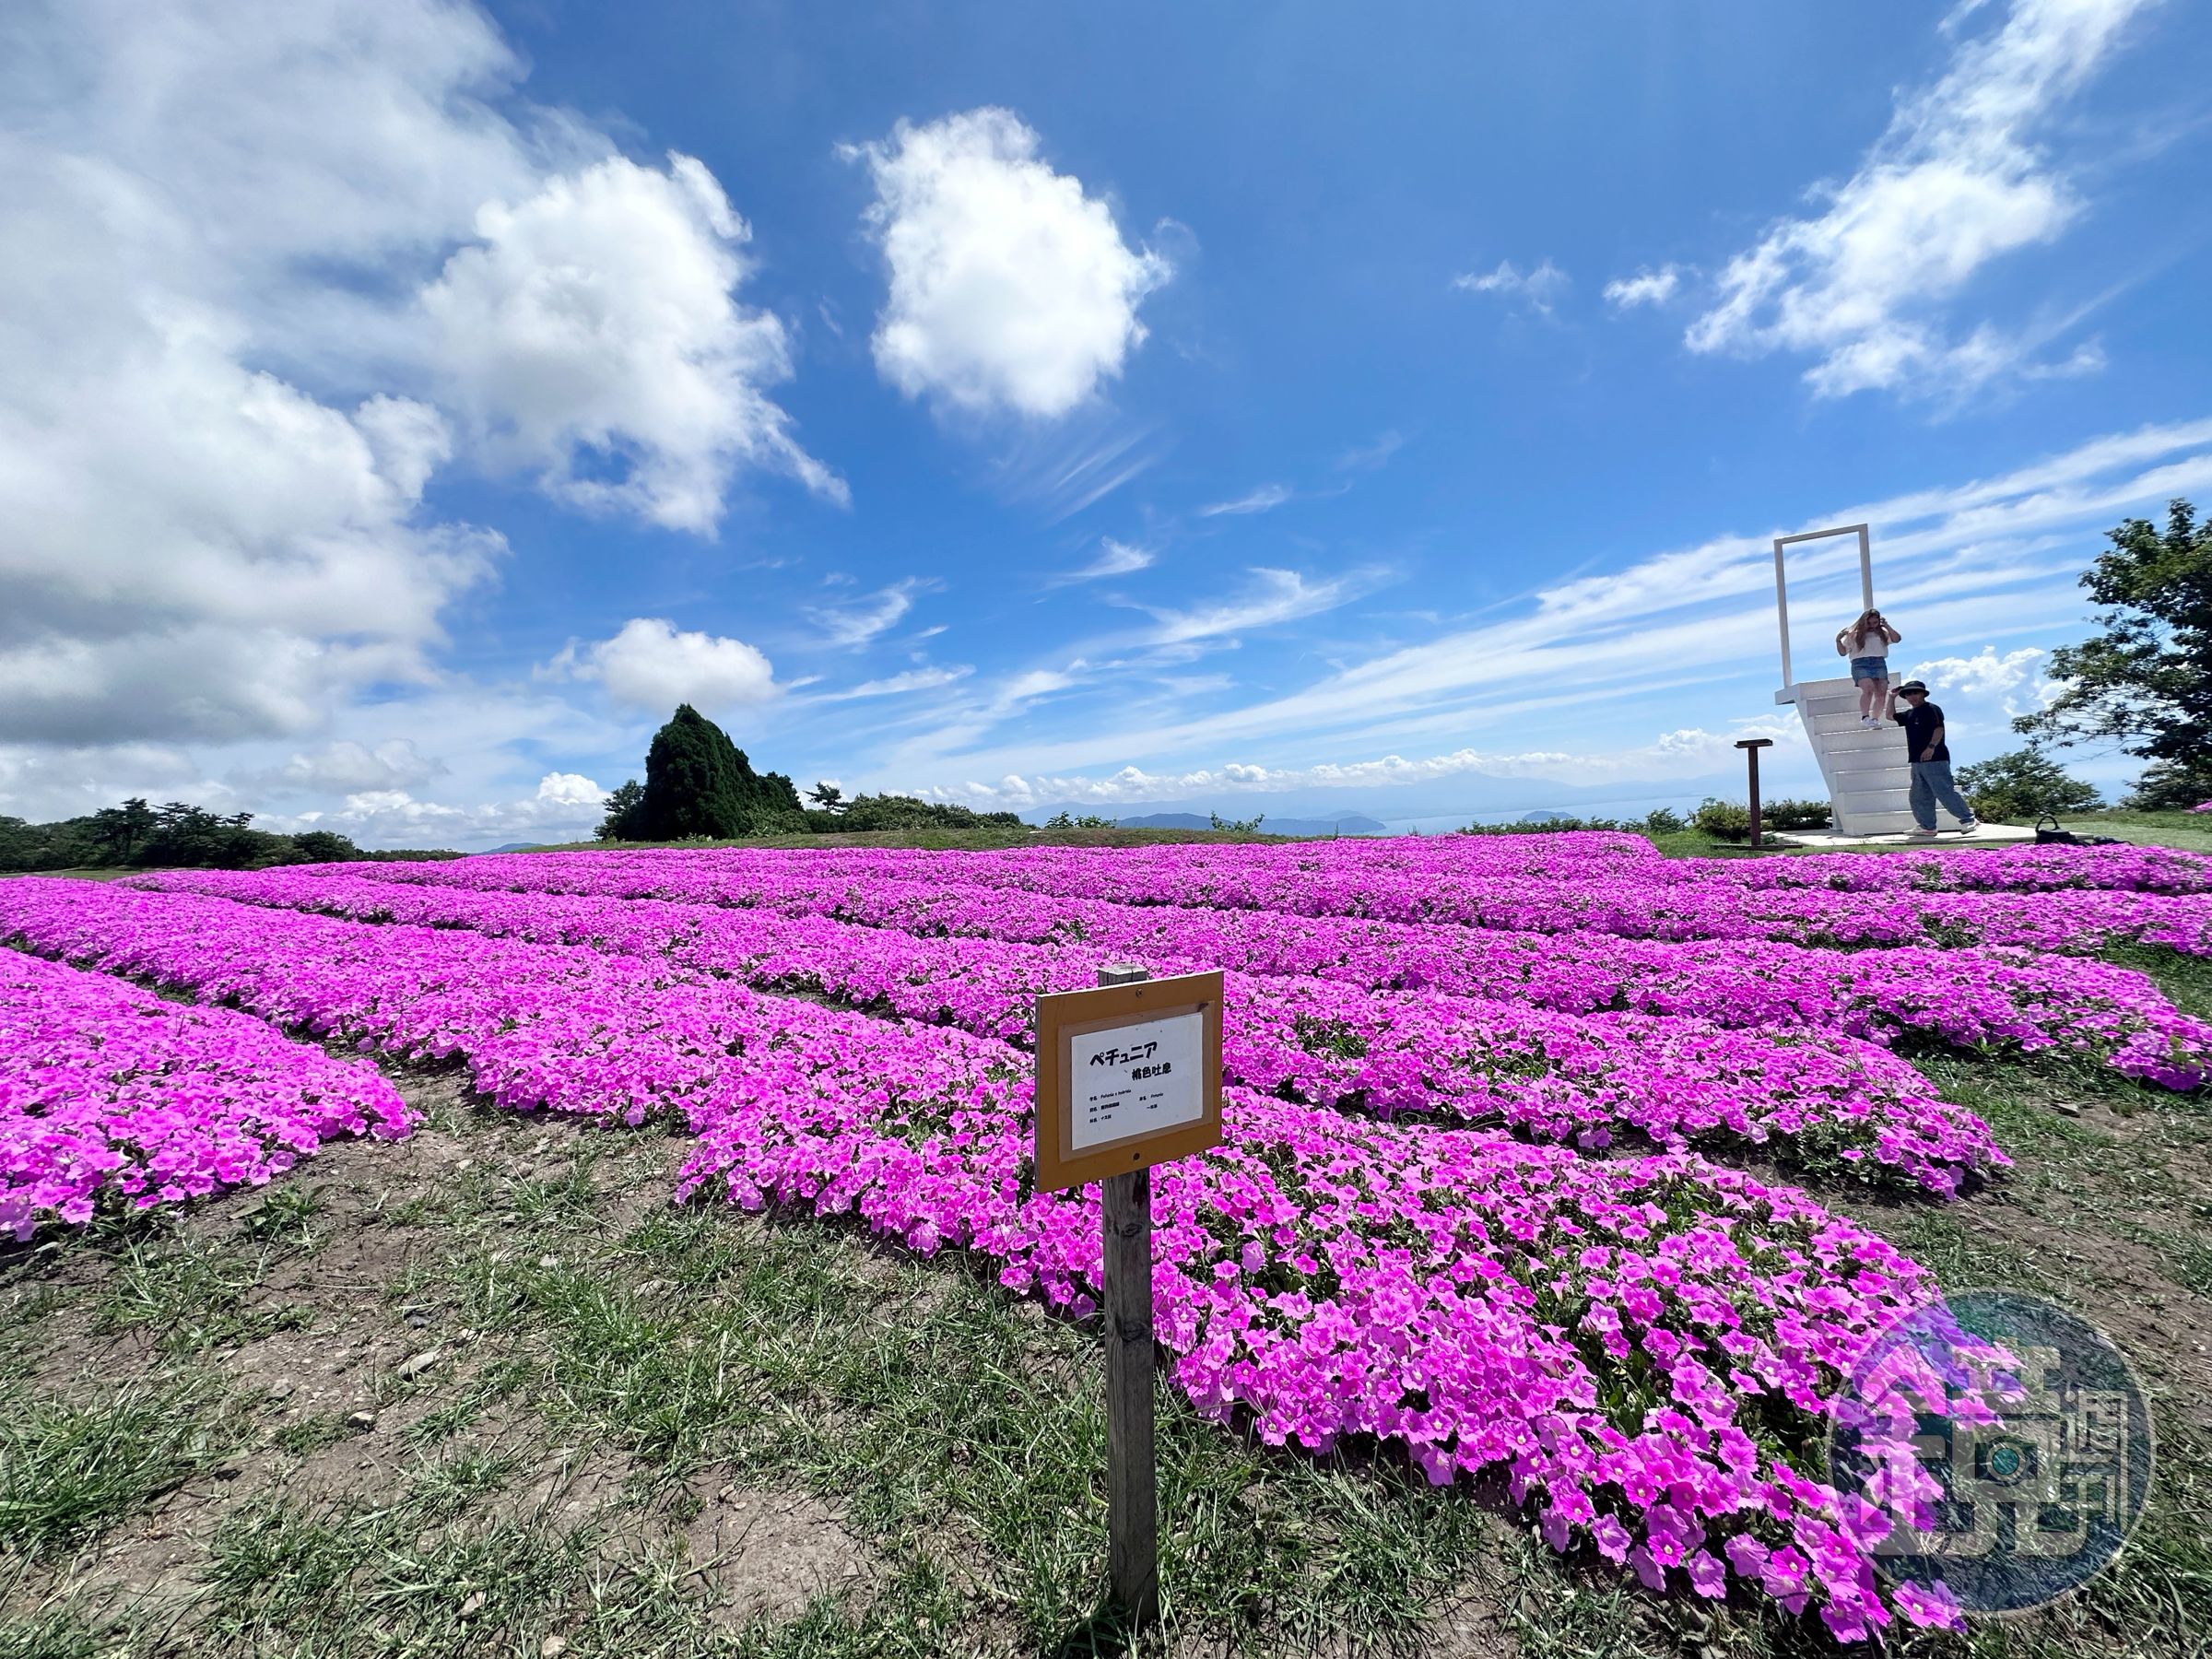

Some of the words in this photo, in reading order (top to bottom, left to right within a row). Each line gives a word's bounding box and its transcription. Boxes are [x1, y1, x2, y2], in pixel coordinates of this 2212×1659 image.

[1090, 1041, 1158, 1065] ペチュニア
